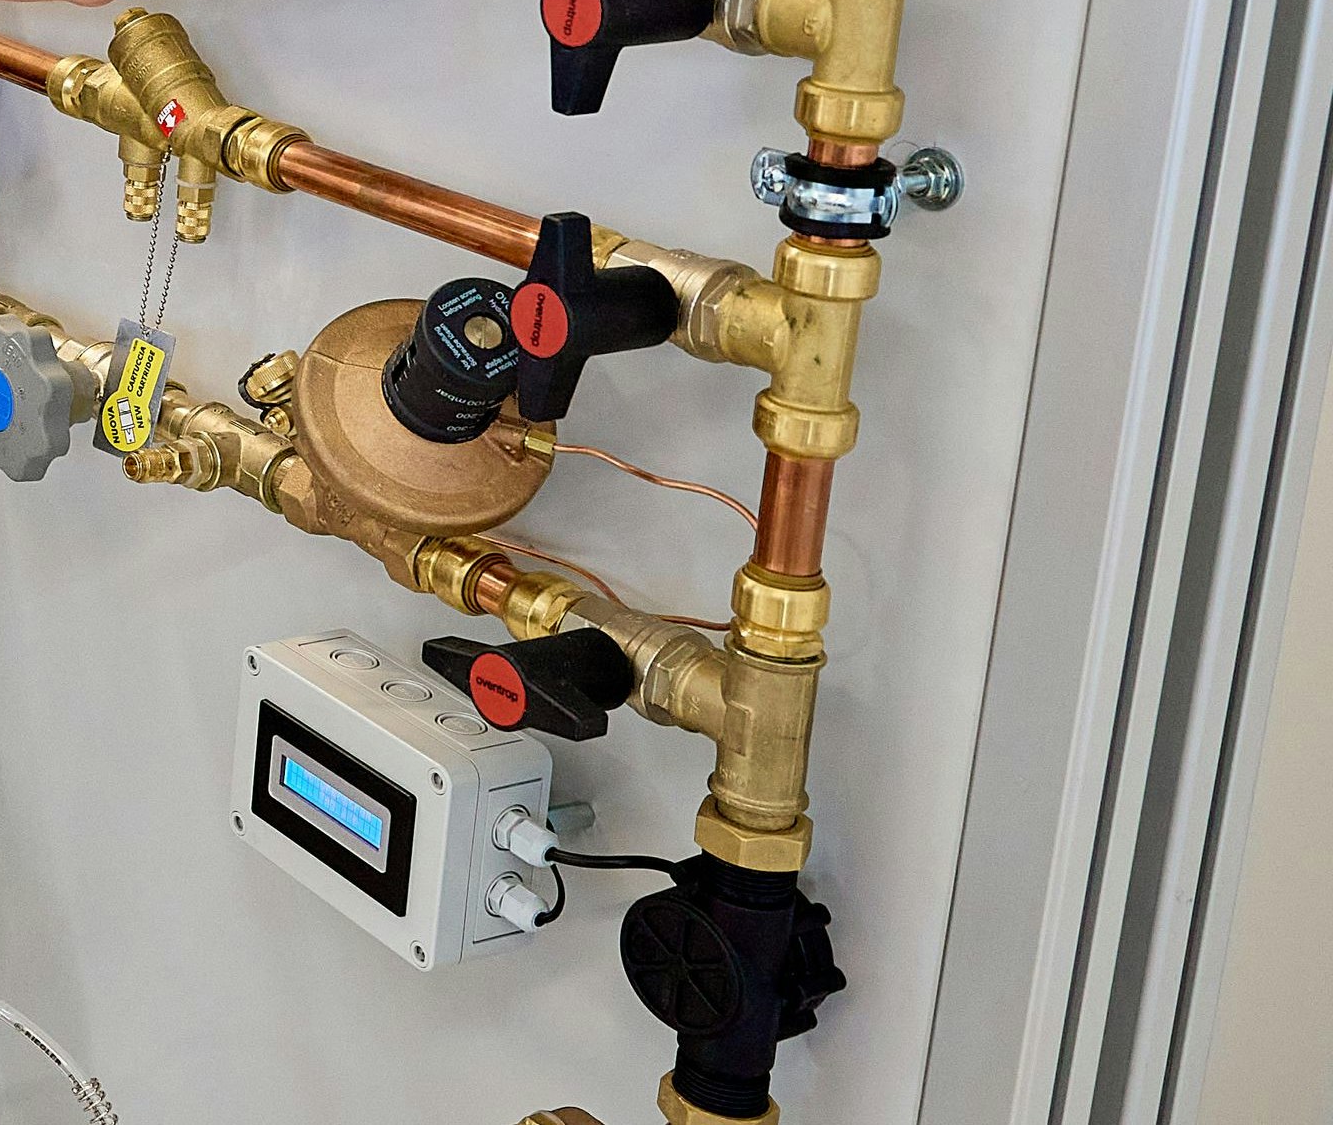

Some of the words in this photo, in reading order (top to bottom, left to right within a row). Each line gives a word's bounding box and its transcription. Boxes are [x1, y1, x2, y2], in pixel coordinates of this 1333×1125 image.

[529, 292, 546, 348] oventrop
[127, 346, 147, 393] CARTUCCIA
[136, 349, 156, 397] CARTRIDGE
[107, 405, 121, 444] NUOVA
[134, 404, 145, 429] NEW
[475, 676, 519, 703] oventrop
[24, 1030, 62, 1066] RIEGLER
